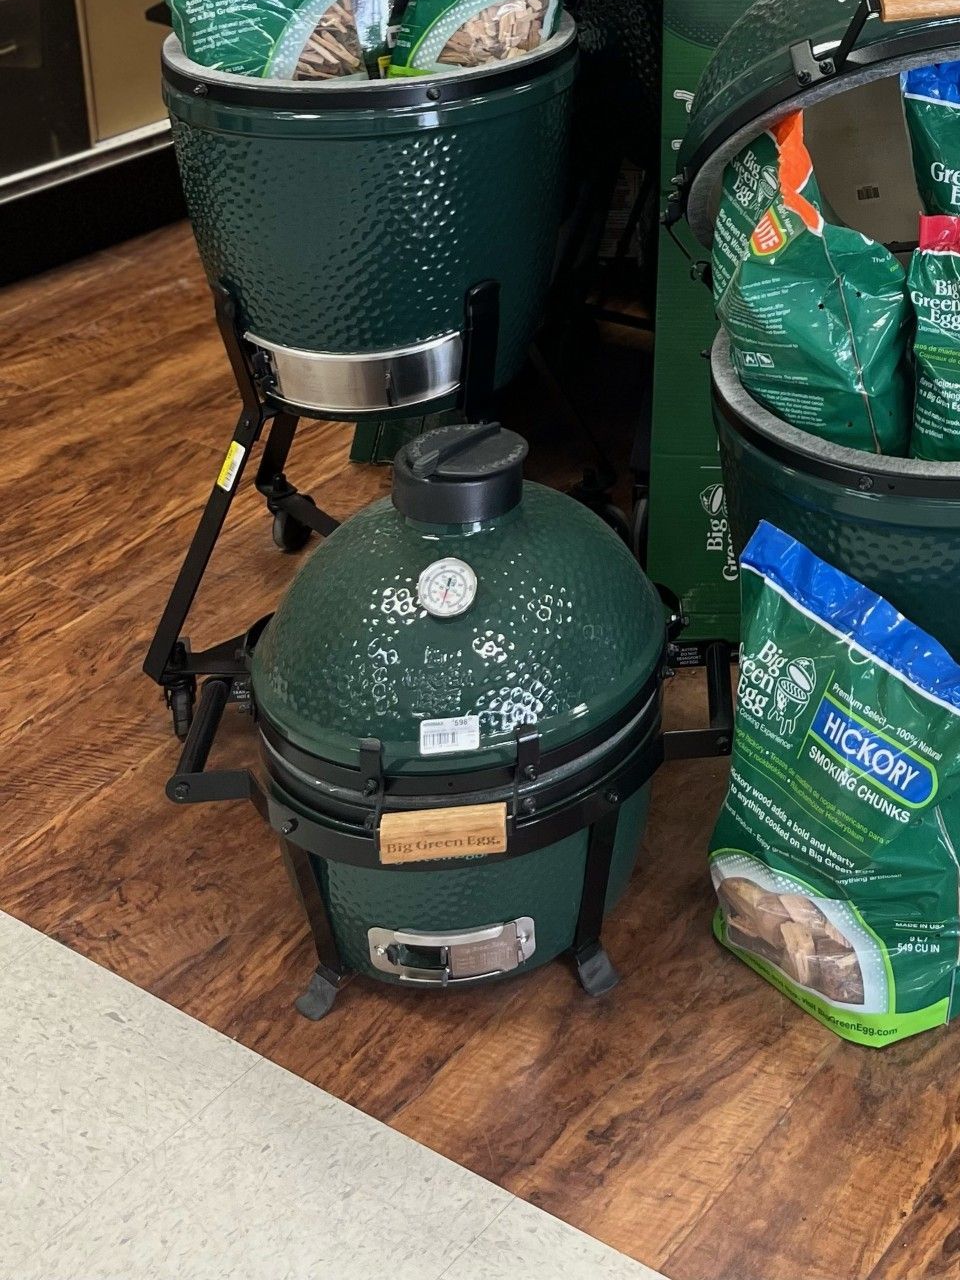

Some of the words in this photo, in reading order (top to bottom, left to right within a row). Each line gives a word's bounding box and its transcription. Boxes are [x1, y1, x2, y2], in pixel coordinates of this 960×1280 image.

[743, 150, 762, 179] Big
[732, 178, 755, 207] Egg
[935, 280, 960, 300] Big
[707, 518, 728, 551] Big
[758, 639, 788, 678] Big
[737, 676, 769, 717] Egg
[739, 707, 761, 730] Cooking
[760, 724, 792, 750] Experience
[832, 682, 862, 710] Premium
[862, 700, 888, 726] Select
[896, 727, 918, 747] 100%
[918, 740, 943, 762] Natural
[823, 712, 920, 791] HICKORY
[809, 745, 858, 791] SMOKING
[857, 785, 911, 824] CHUNKS
[730, 783, 737, 794] to
[737, 790, 765, 820] anything
[765, 814, 790, 841] cooked
[789, 838, 801, 849] on
[801, 845, 808, 853] a
[808, 847, 823, 863] Big
[824, 857, 852, 875] Green
[752, 787, 772, 808] wood
[771, 801, 787, 822] adds
[787, 819, 793, 827] a
[792, 821, 810, 841] bold
[809, 834, 827, 852] and
[826, 842, 855, 868] hearty
[836, 807, 868, 834] americano
[387, 842, 413, 854] Big
[416, 837, 464, 850] Green
[835, 875, 868, 885] anything
[897, 942, 913, 953] 549
[914, 943, 929, 953] CU
[930, 944, 940, 953] IN
